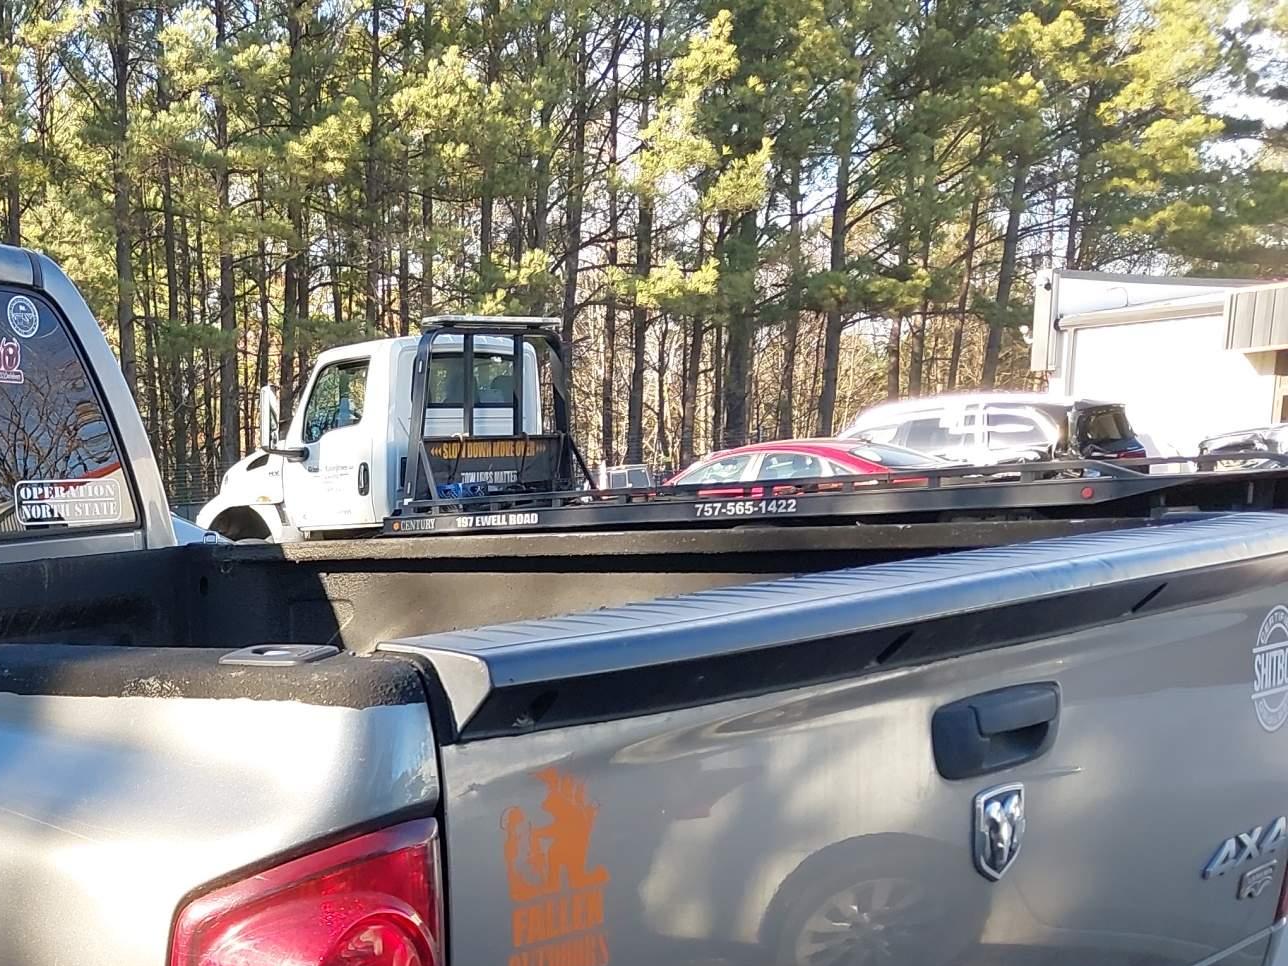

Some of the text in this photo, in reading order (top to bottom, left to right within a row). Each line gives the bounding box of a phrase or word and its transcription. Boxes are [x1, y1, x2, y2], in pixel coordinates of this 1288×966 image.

[467, 441, 492, 458] DOWN
[492, 441, 515, 458] MOVE
[20, 483, 115, 500] OPERATION
[21, 502, 118, 520] NORTH STATE
[694, 499, 797, 517] 757-565-1422
[400, 519, 436, 531] CENTURY
[455, 513, 538, 528] 197 EWELL ROAD
[1254, 647, 1288, 692] SHITB
[1203, 815, 1287, 876] 4X4
[513, 888, 605, 948] FALLEN
